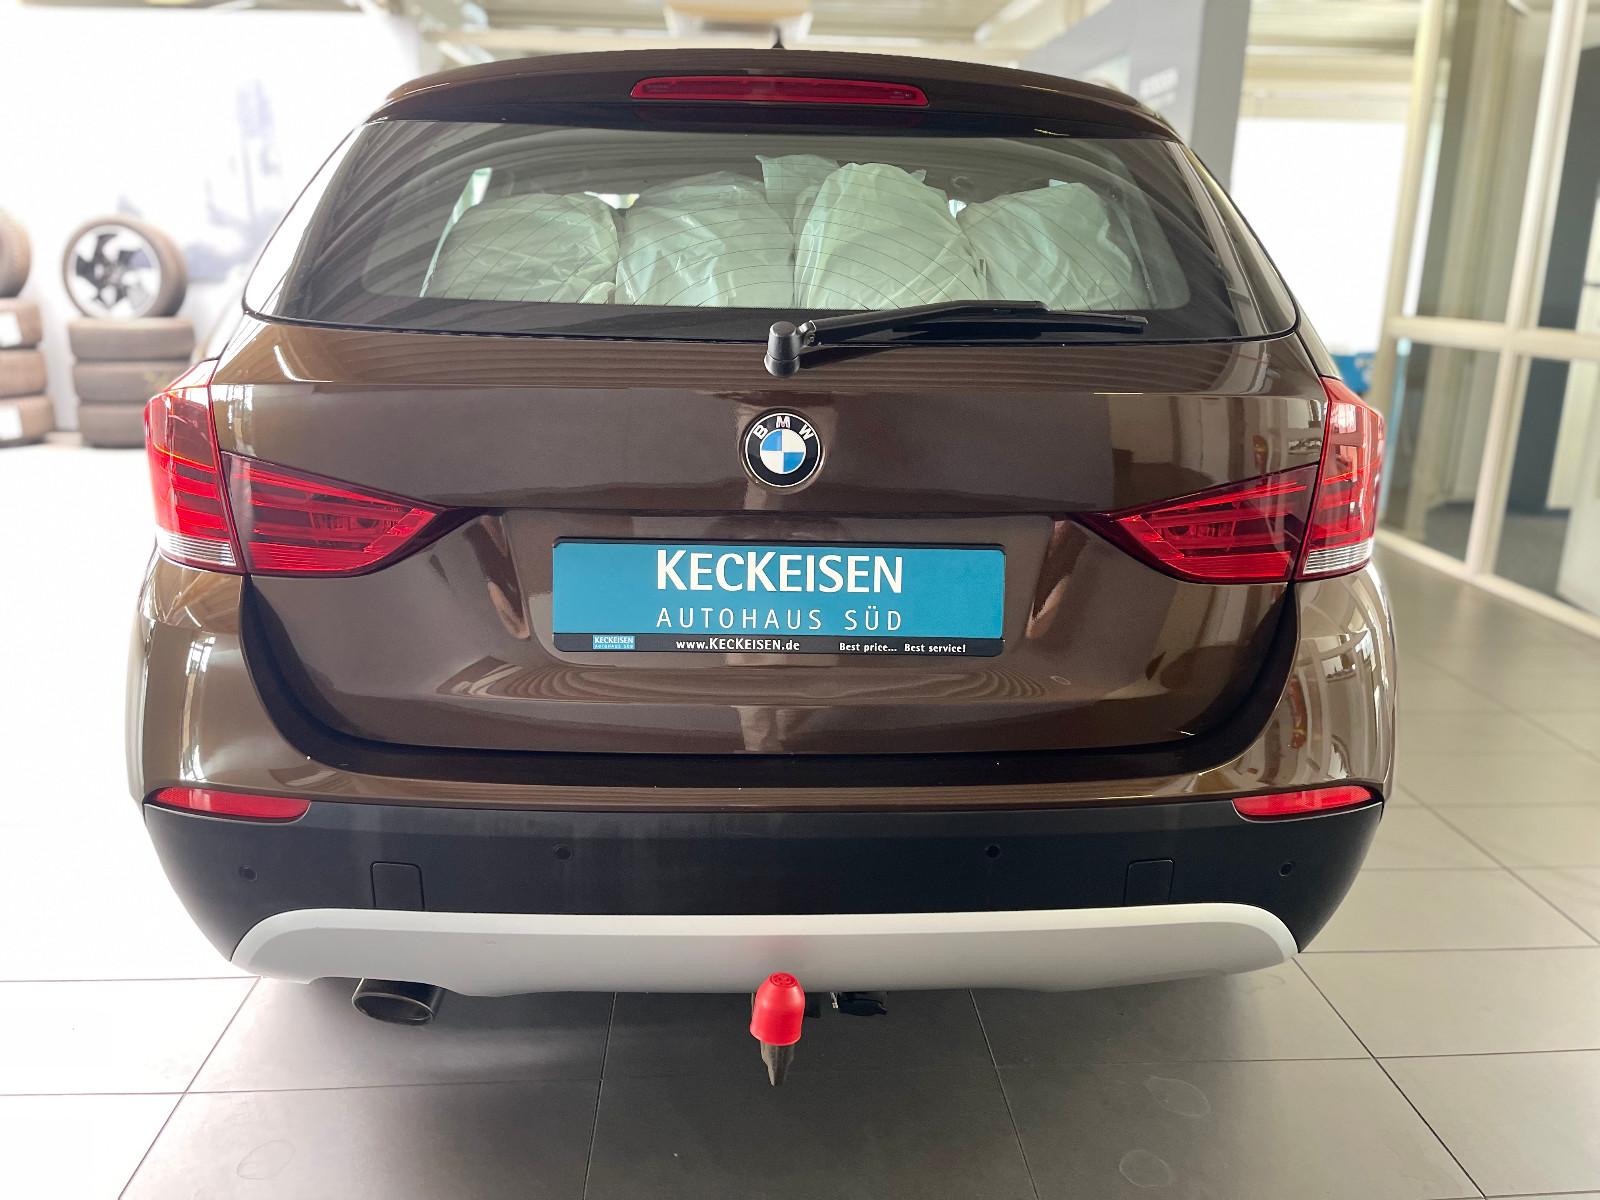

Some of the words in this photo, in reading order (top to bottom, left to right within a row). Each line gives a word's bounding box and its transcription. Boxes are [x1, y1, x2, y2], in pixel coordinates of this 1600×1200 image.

[753, 416, 815, 440] BMW
[657, 550, 903, 593] KECKEISEN
[656, 607, 822, 630] AUTOHAUS
[844, 605, 902, 632] SÜD
[675, 637, 800, 651] www.KECKEISEN.de
[839, 642, 861, 651] Best
[863, 642, 897, 653] price...
[904, 643, 925, 652] Best
[928, 644, 966, 653] service!
